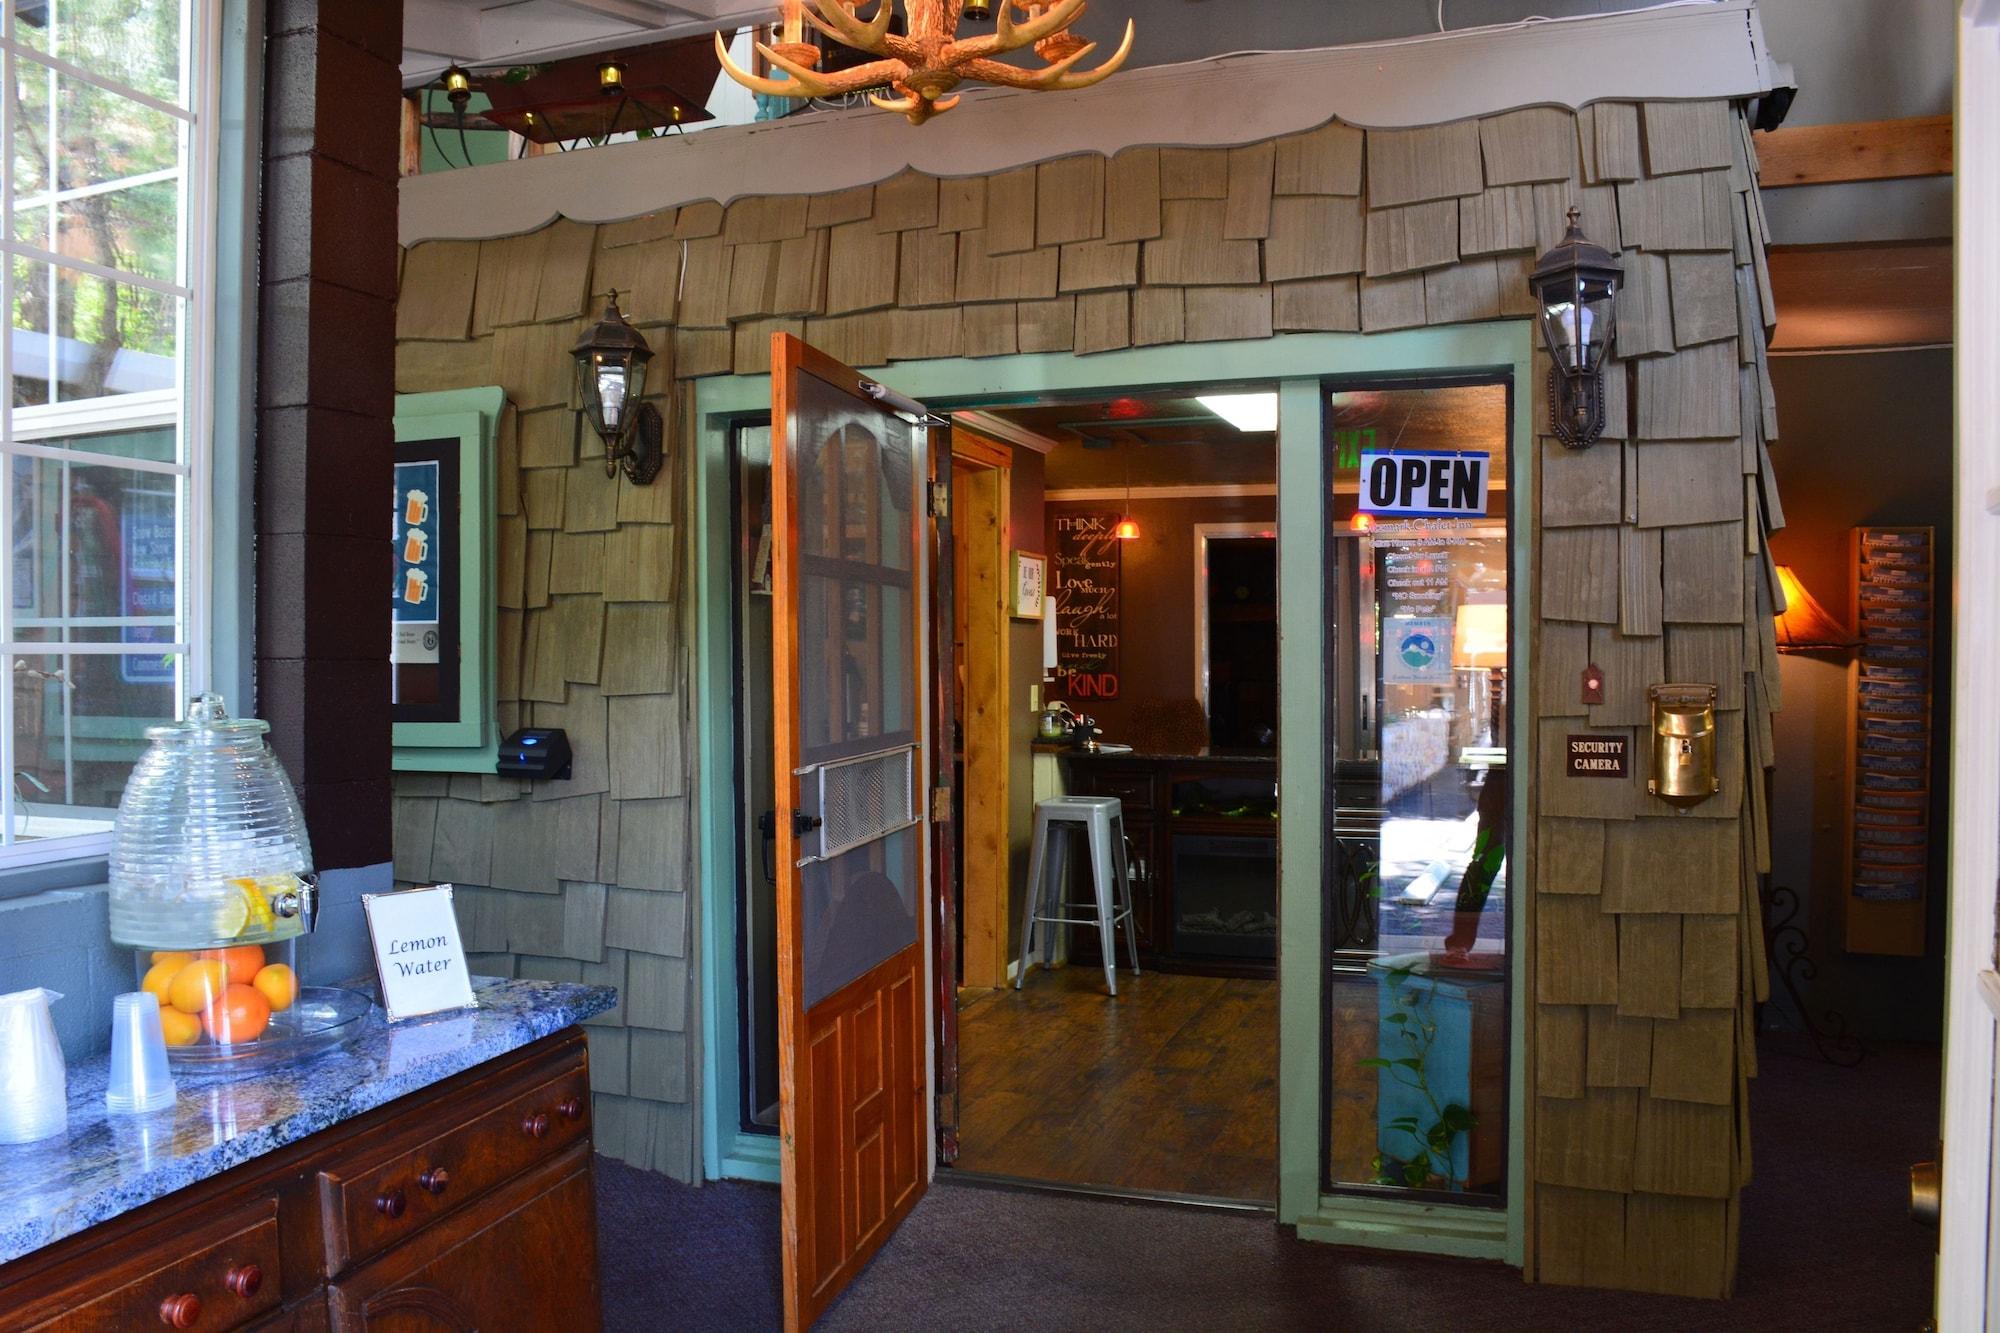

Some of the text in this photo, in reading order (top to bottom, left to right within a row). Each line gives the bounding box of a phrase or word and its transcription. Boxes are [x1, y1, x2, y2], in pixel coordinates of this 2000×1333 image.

[1369, 457, 1480, 509] OPEN
[1055, 518, 1106, 531] THINK
[1412, 518, 1450, 531] Chalet
[1453, 517, 1472, 529] Inn
[1054, 552, 1116, 570] Speak gently
[1056, 570, 1093, 591] Love
[1387, 579, 1411, 587] Check
[1435, 578, 1449, 586] AM
[1056, 588, 1115, 628] laugh
[1074, 633, 1119, 648] HARD
[1057, 664, 1077, 678] be
[1068, 673, 1119, 697] KIND
[1571, 741, 1623, 753] SECURITY
[1574, 758, 1621, 771] CAMERA
[389, 935, 449, 955] Lemon
[393, 958, 452, 977] Water
